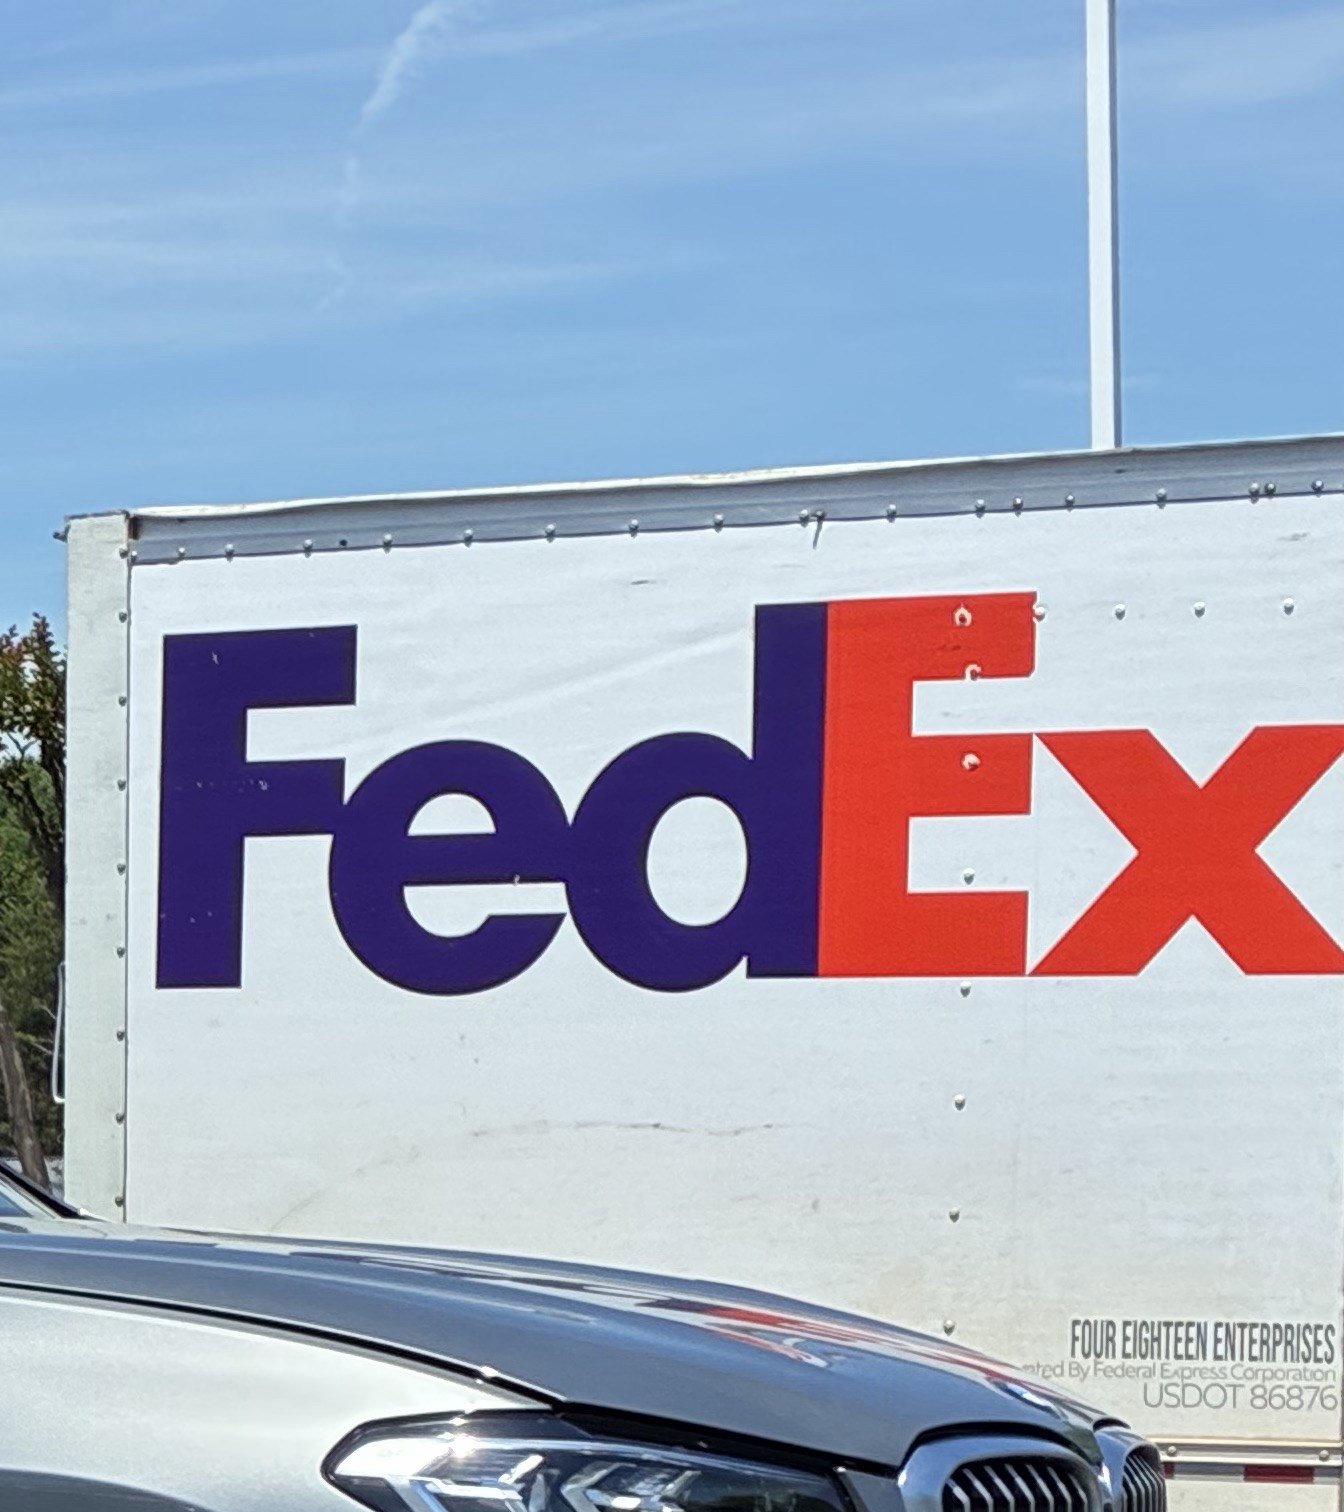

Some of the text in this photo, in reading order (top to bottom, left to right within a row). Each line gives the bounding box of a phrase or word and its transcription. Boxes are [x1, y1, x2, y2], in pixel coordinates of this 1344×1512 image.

[156, 591, 1344, 995] FedEx
[1070, 1318, 1336, 1365] FOUR EIGHTEEN ENTERPRISES
[1068, 1361, 1091, 1382] By
[1093, 1359, 1157, 1379] Federal
[1160, 1362, 1228, 1384] Express
[1230, 1363, 1337, 1383] Corporation
[1143, 1382, 1339, 1411] USDOT 86876
